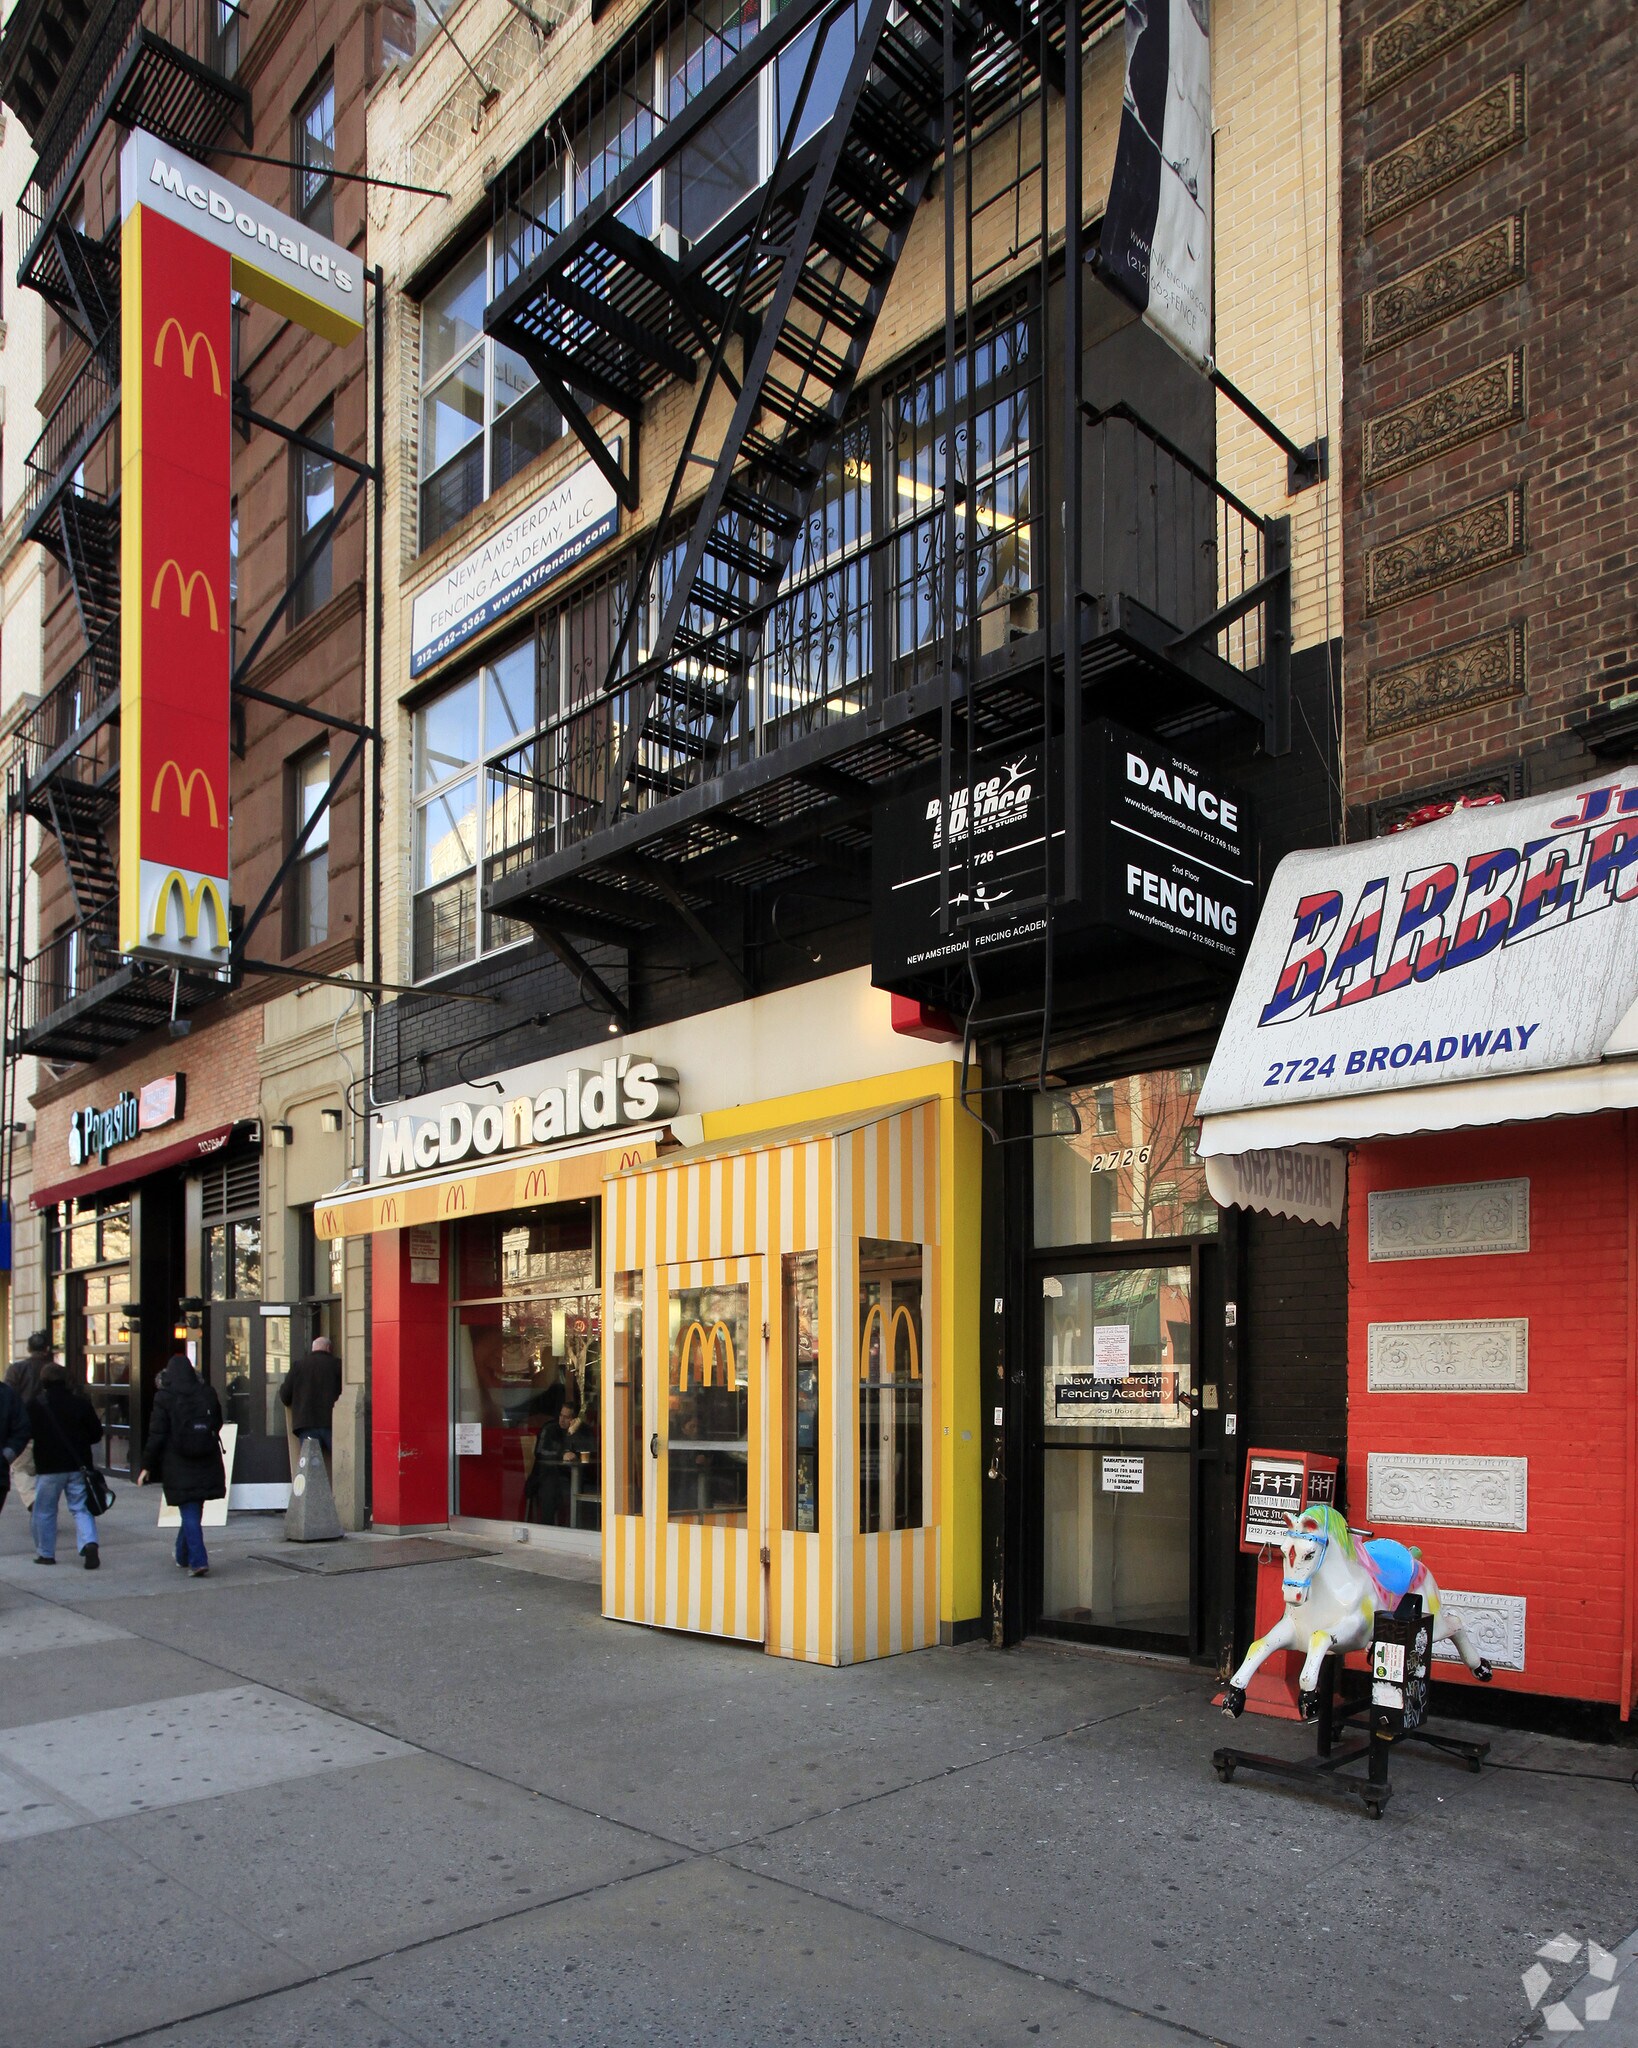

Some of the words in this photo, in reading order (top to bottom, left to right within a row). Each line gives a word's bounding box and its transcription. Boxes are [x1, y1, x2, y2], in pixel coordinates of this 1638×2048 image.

[150, 158, 353, 293] McDonald's
[447, 560, 479, 594] NEW
[481, 488, 573, 563] AMSTERDAM
[430, 580, 487, 633] FENCING
[489, 521, 564, 590] ACADEMY,
[568, 498, 594, 530] LLC
[416, 608, 486, 667] 212-662-3362
[492, 520, 611, 612] www.NYFencing.com
[1171, 758, 1182, 770] 3rd
[1182, 761, 1199, 777] Floor
[1126, 752, 1238, 833] DANCE
[995, 812, 1028, 829] STUDIOS
[1124, 796, 1200, 837] www.bridgefordance.com
[967, 850, 995, 869] 726
[1171, 864, 1184, 876] 2nd
[1184, 868, 1200, 883] Floor
[1126, 863, 1238, 936] FENCING
[1257, 815, 1638, 1028] BARBER
[907, 953, 924, 965] NEW
[925, 940, 970, 960] AMSTERDA
[975, 929, 1011, 946] FENCING
[1128, 908, 1188, 937] www.nyfencing.com
[1216, 941, 1236, 956] FENCE
[1263, 1053, 1335, 1087] 2724
[1344, 1023, 1540, 1075] BROADWAY
[84, 1091, 138, 1165] Papasito
[378, 1053, 672, 1178] McDonald's
[1092, 1147, 1150, 1172] 2726
[1061, 1388, 1109, 1401] Fencing
[1112, 1388, 1172, 1401] Academy
[1063, 1376, 1092, 1386] New
[1094, 1376, 1169, 1386] Amsterdam
[1248, 1526, 1263, 1535] (212)
[1249, 1507, 1269, 1517] DANCE
